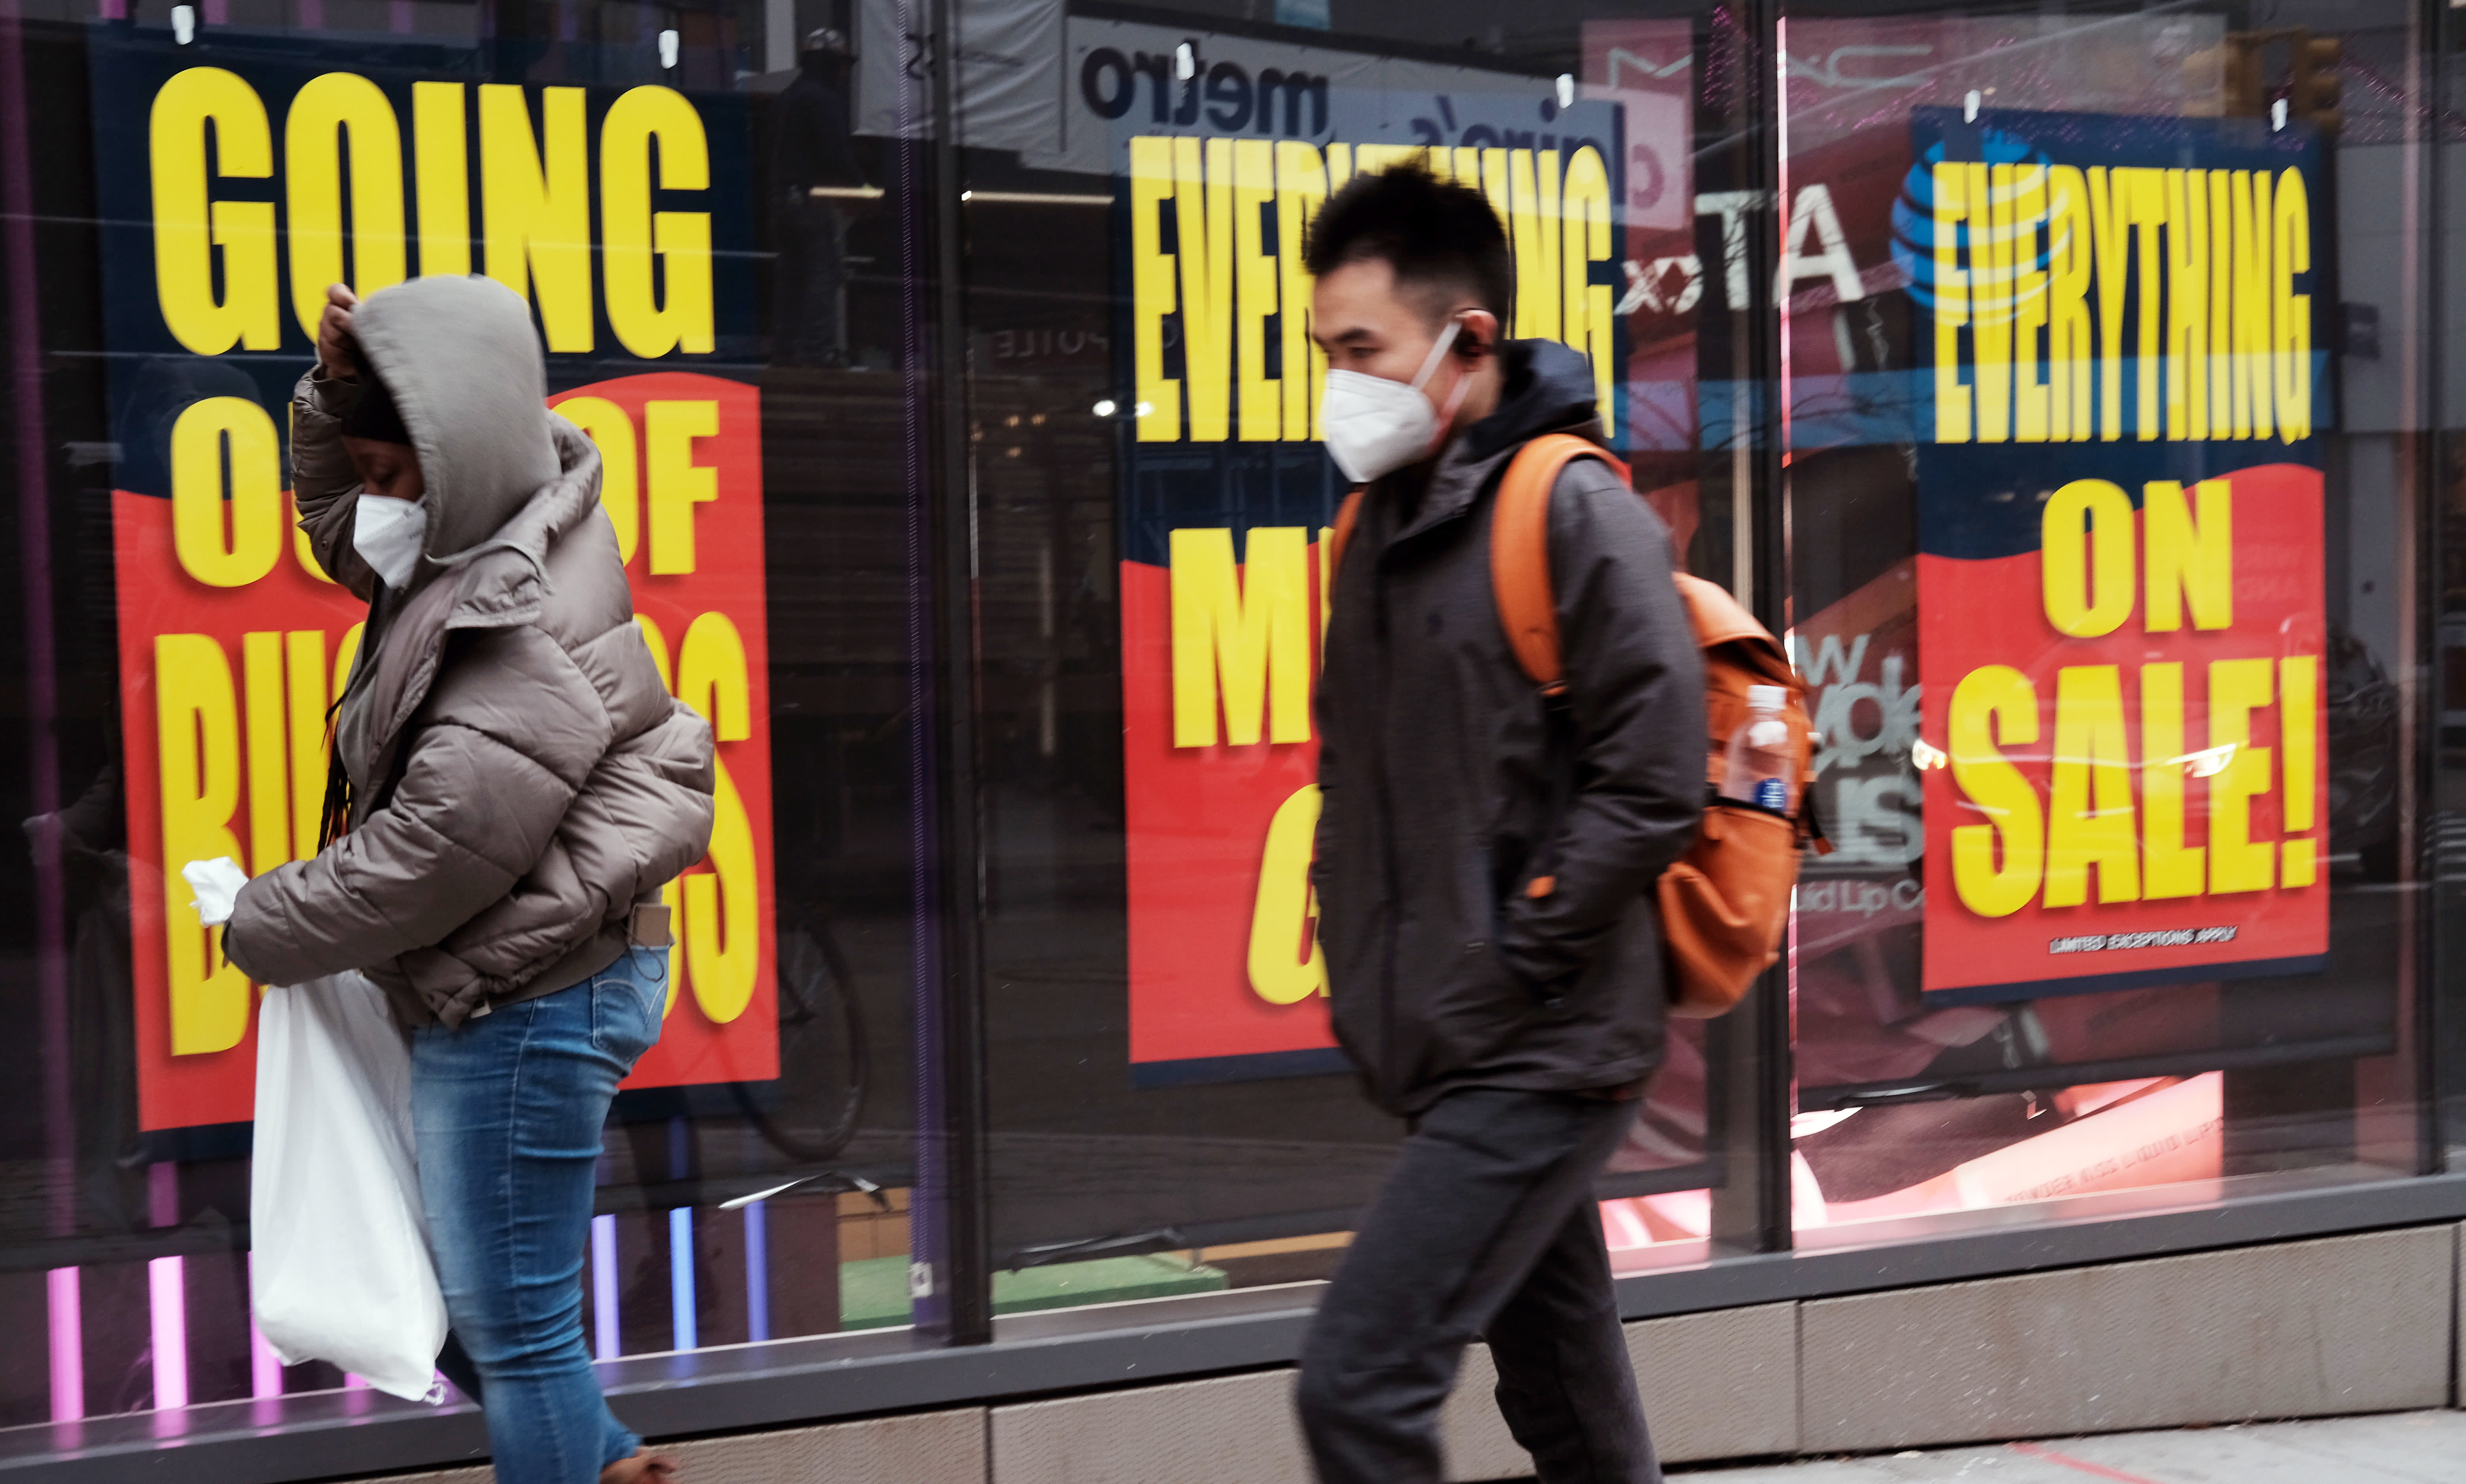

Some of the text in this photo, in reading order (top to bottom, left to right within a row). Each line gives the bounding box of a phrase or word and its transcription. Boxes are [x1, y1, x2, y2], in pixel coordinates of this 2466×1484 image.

[150, 66, 715, 359] GOING
[1129, 136, 1615, 442] EVERNG
[1932, 161, 2311, 445] EVERYTHING
[2042, 479, 2232, 637] ON
[1948, 655, 2317, 918] SALE!
[2049, 925, 2239, 954] LIMITED EXCEPTIONS APPLY
